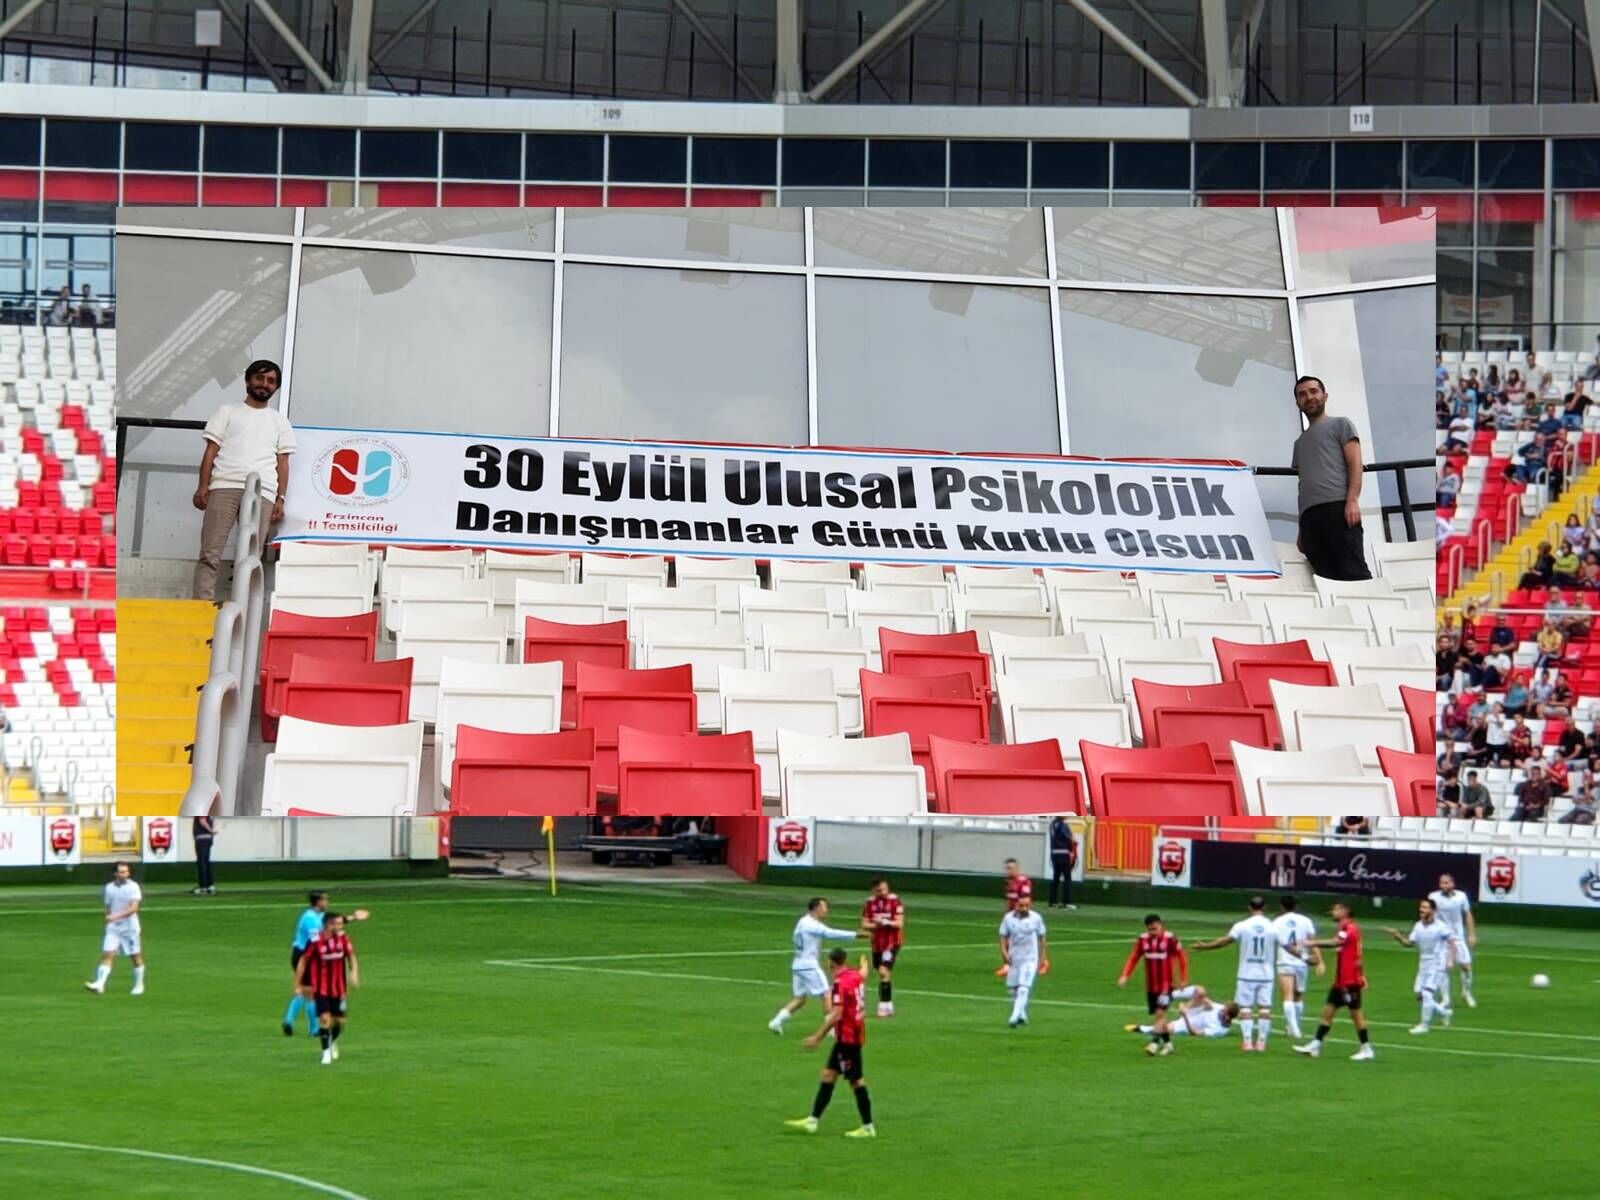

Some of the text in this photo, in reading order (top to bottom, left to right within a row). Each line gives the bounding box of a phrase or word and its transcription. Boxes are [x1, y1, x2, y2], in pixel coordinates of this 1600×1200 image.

[603, 108, 622, 120] 109
[1353, 112, 1371, 125] 110
[463, 444, 544, 492] 30
[562, 451, 707, 503] Eylül
[724, 459, 917, 509] Ulusal
[930, 466, 1235, 521] Psikolojik
[326, 512, 385, 521] Erzincan
[456, 501, 1255, 561] Danışmanlar Günü Kutlu Olsun
